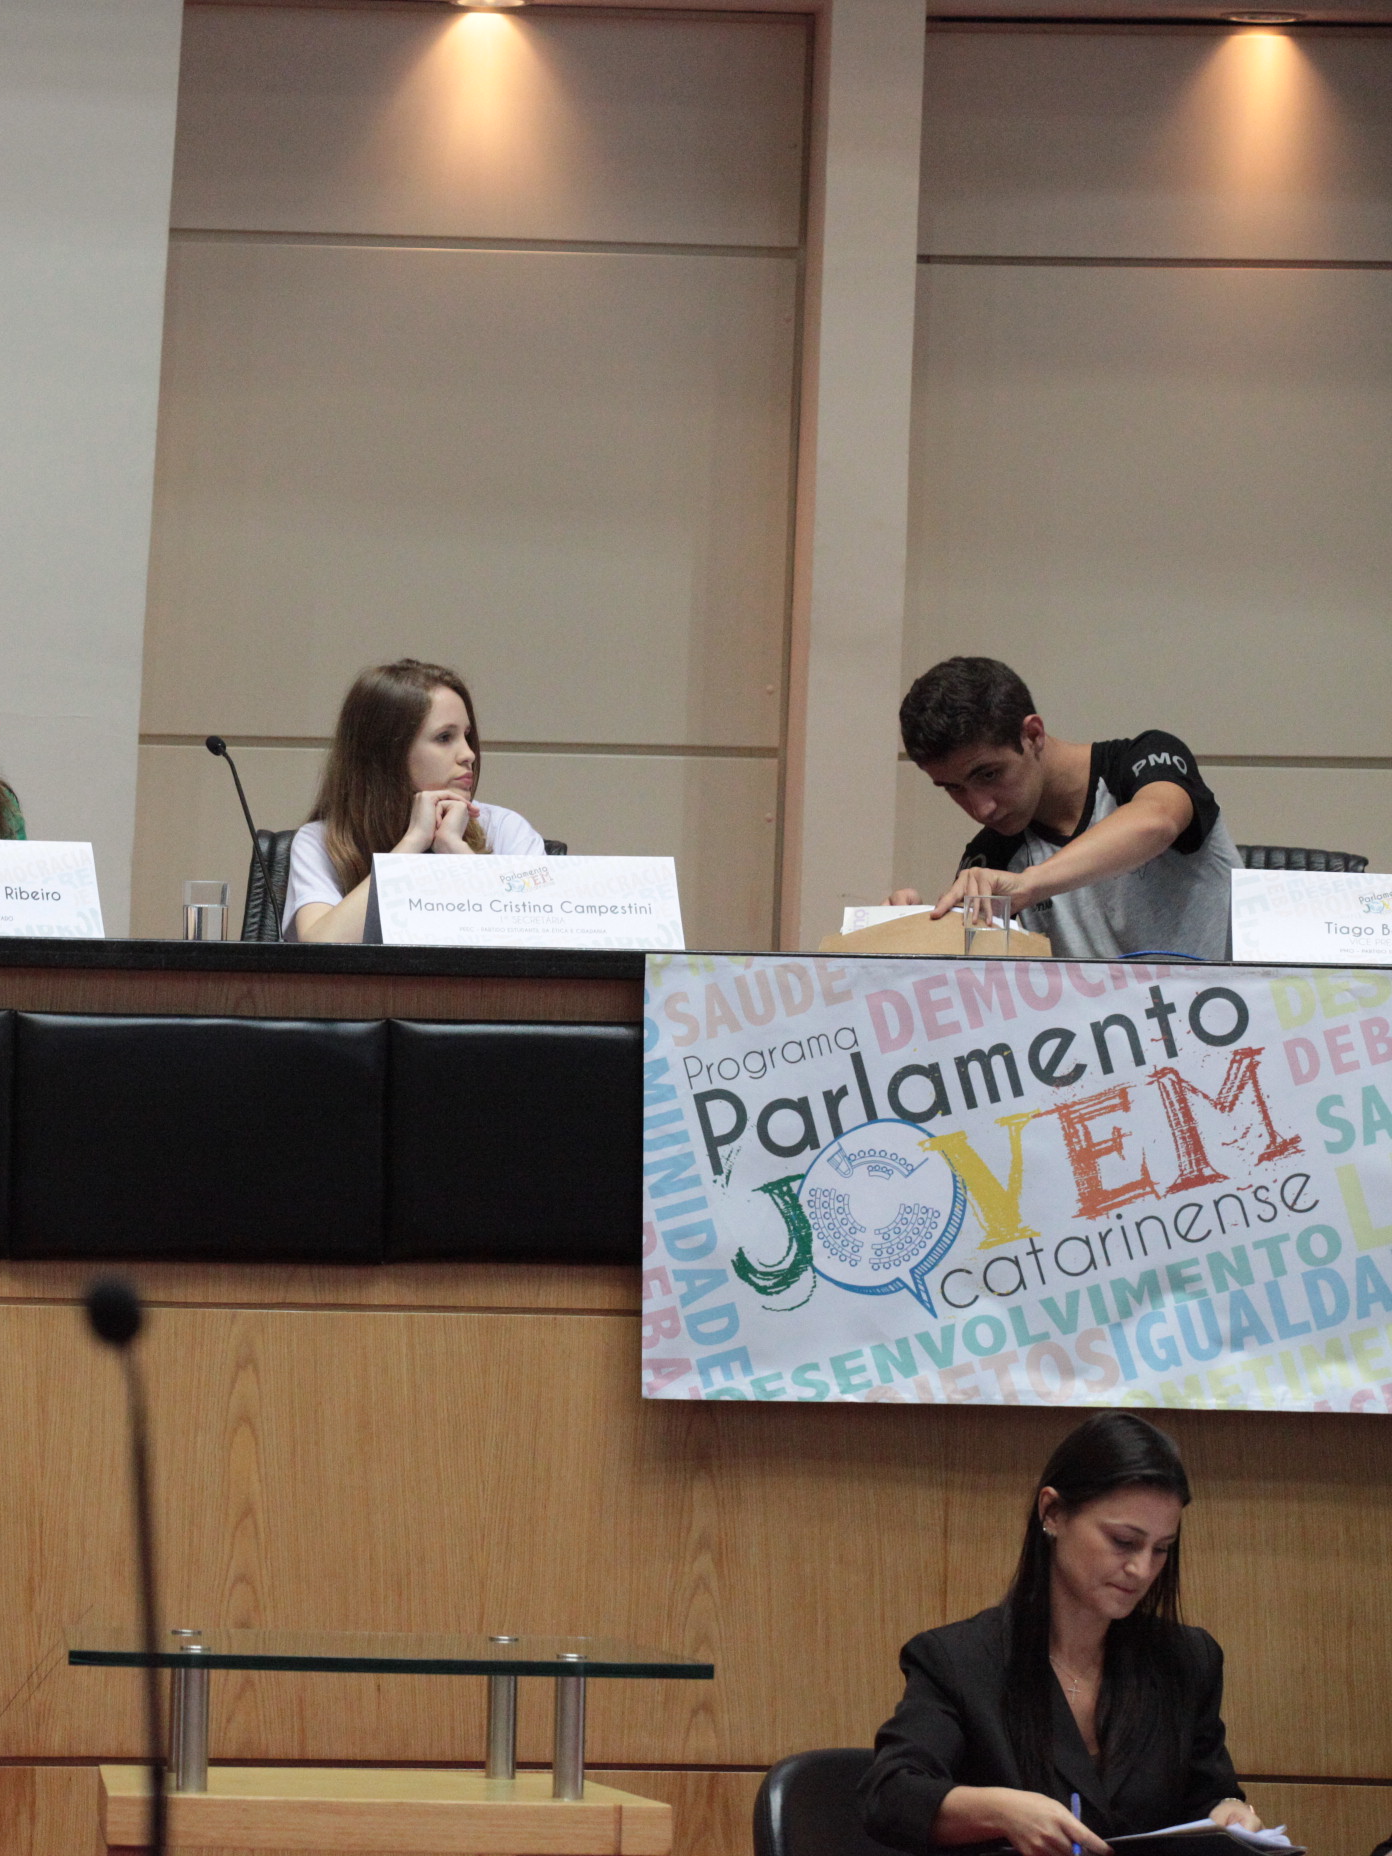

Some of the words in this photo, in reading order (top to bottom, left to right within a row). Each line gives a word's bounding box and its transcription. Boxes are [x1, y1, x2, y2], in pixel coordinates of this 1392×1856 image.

[1131, 751, 1188, 778] PMO
[5, 886, 61, 902] Ribeiro
[408, 897, 483, 913] Manoela
[489, 899, 554, 914] Cristina
[560, 900, 653, 917] Campestini
[1324, 921, 1375, 937] Tiago
[664, 959, 854, 1048] SAÚDE
[683, 1027, 859, 1090] Programa
[693, 985, 1249, 1176] Parlamento
[731, 1047, 1305, 1318] JOVEM
[940, 1173, 1320, 1309] catarinense
